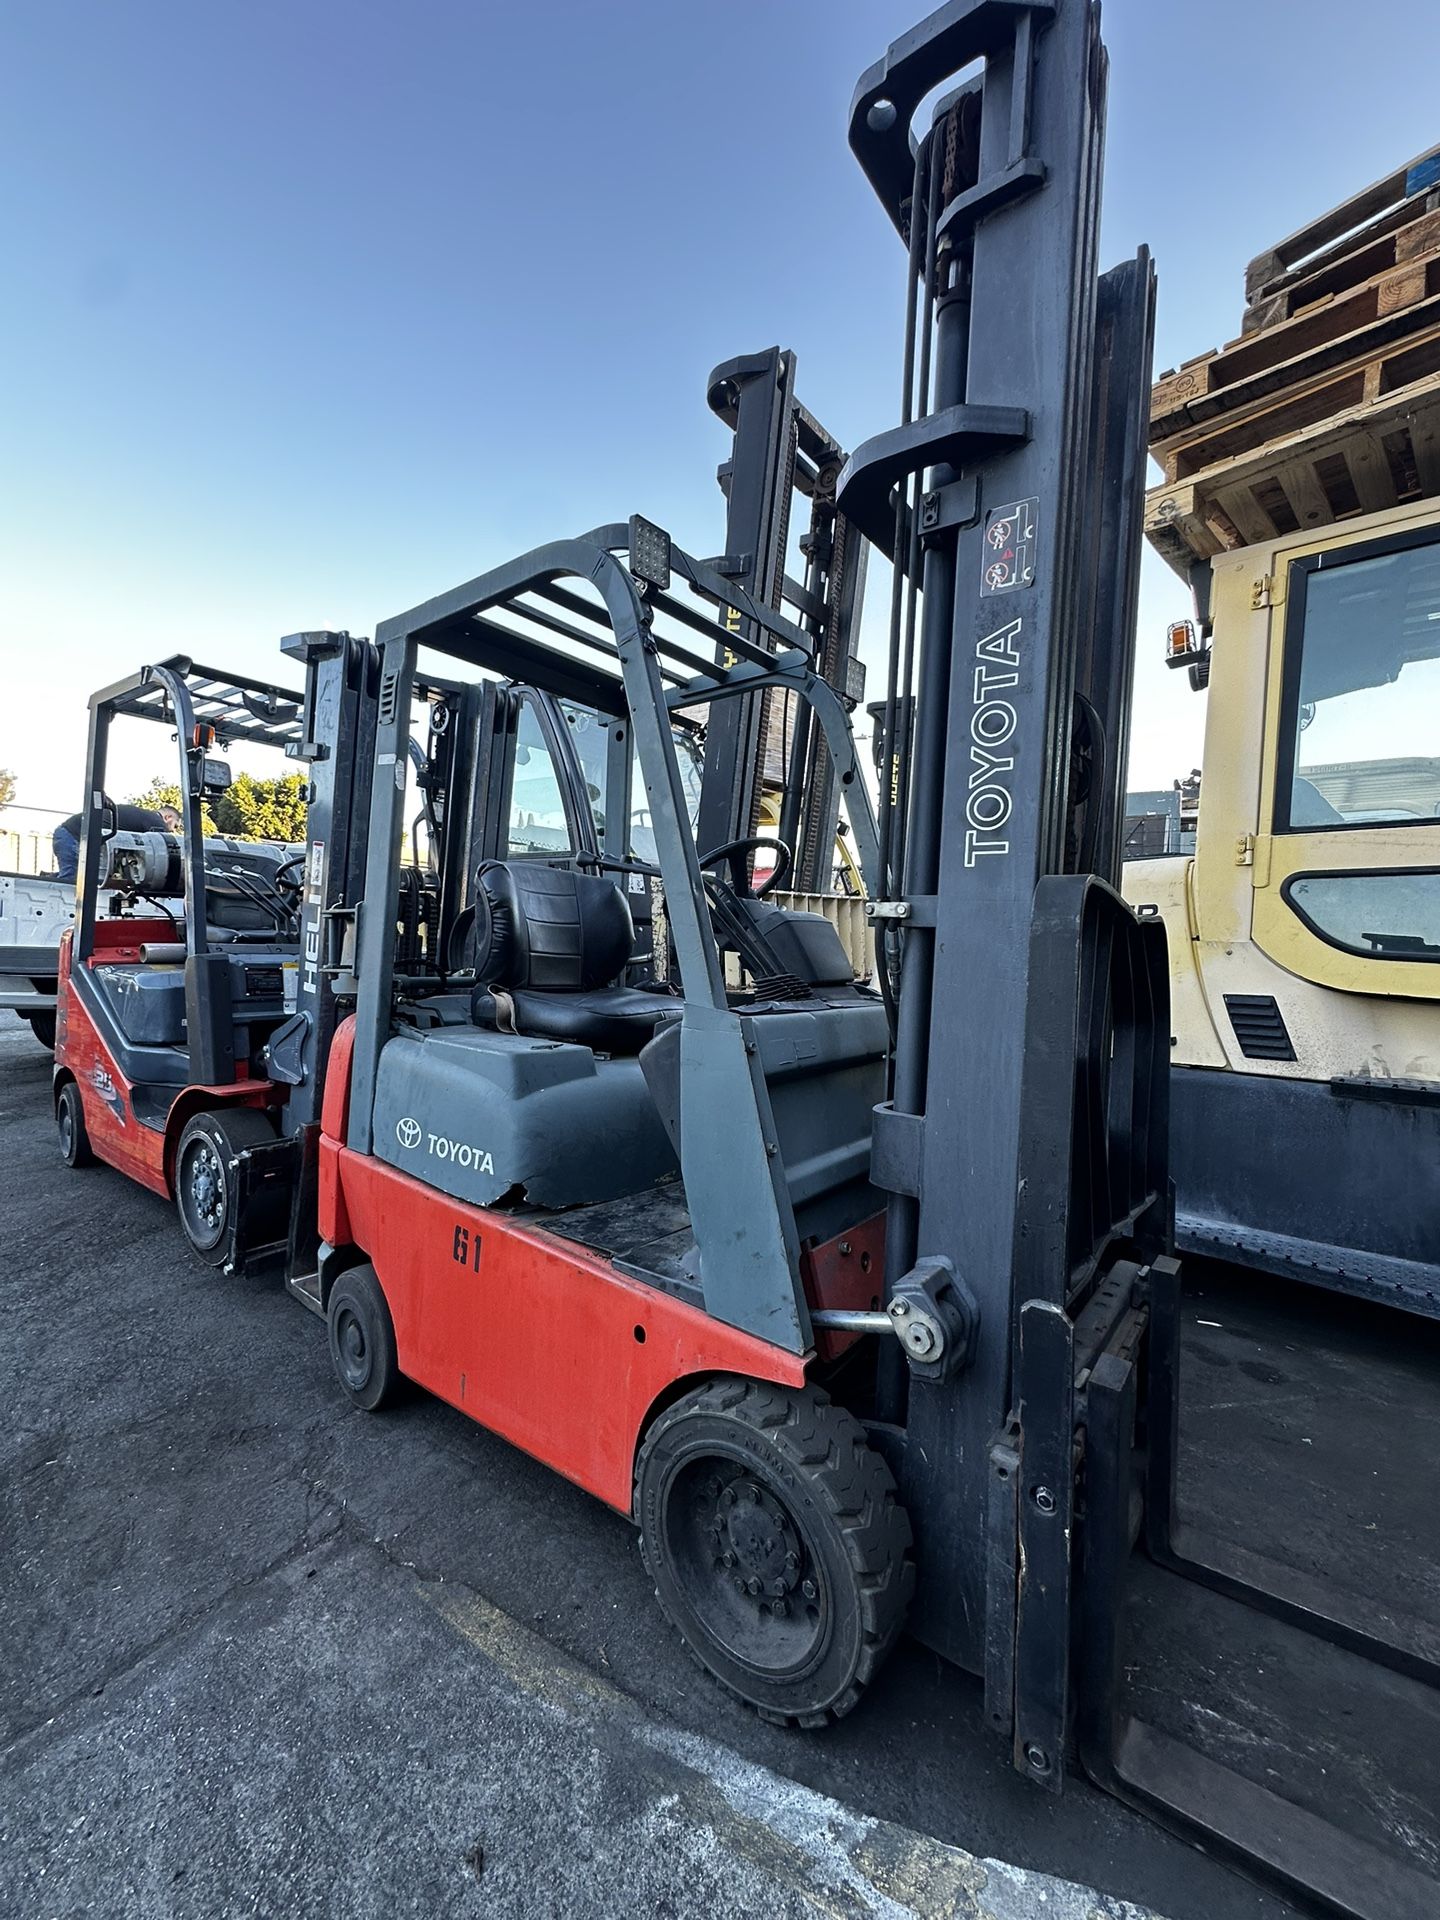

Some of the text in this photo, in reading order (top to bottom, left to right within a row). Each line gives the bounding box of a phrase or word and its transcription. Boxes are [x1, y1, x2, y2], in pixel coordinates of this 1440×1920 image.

[964, 617, 1023, 868] TOYOTA
[303, 893, 322, 994] HELI
[427, 1133, 495, 1176] TOYOTA
[453, 1224, 482, 1274] 61
